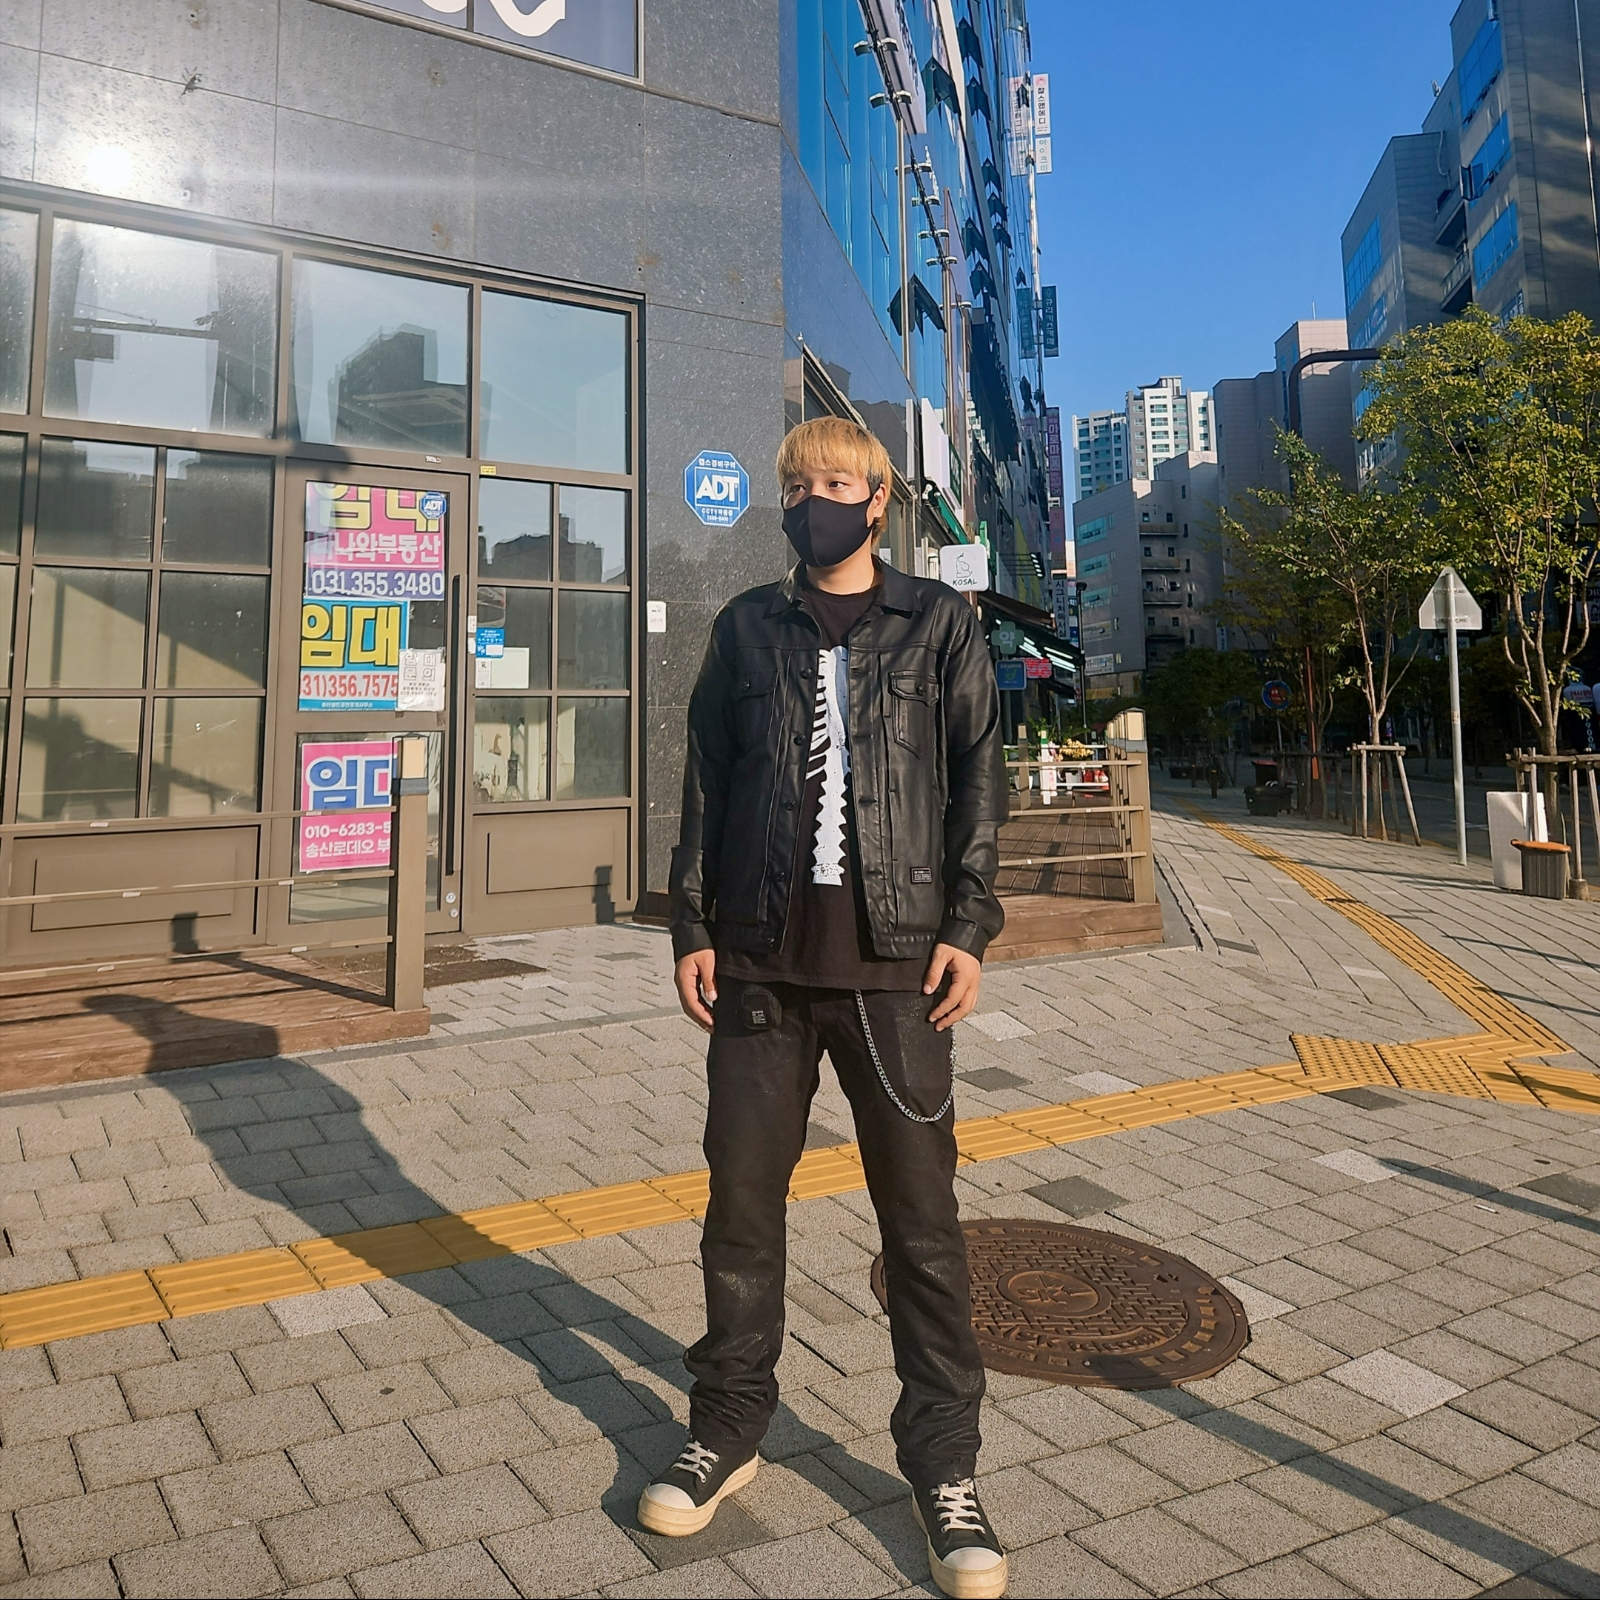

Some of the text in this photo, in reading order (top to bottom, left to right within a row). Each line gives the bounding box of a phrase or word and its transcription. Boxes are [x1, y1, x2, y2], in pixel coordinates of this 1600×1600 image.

[696, 474, 739, 502] ADT
[423, 500, 443, 511] ADT
[312, 571, 444, 595] 031.355.3480
[952, 577, 978, 586] KOSAL
[301, 604, 400, 668] 임대
[999, 631, 1016, 648] 약
[306, 839, 375, 858] 송산로데오
